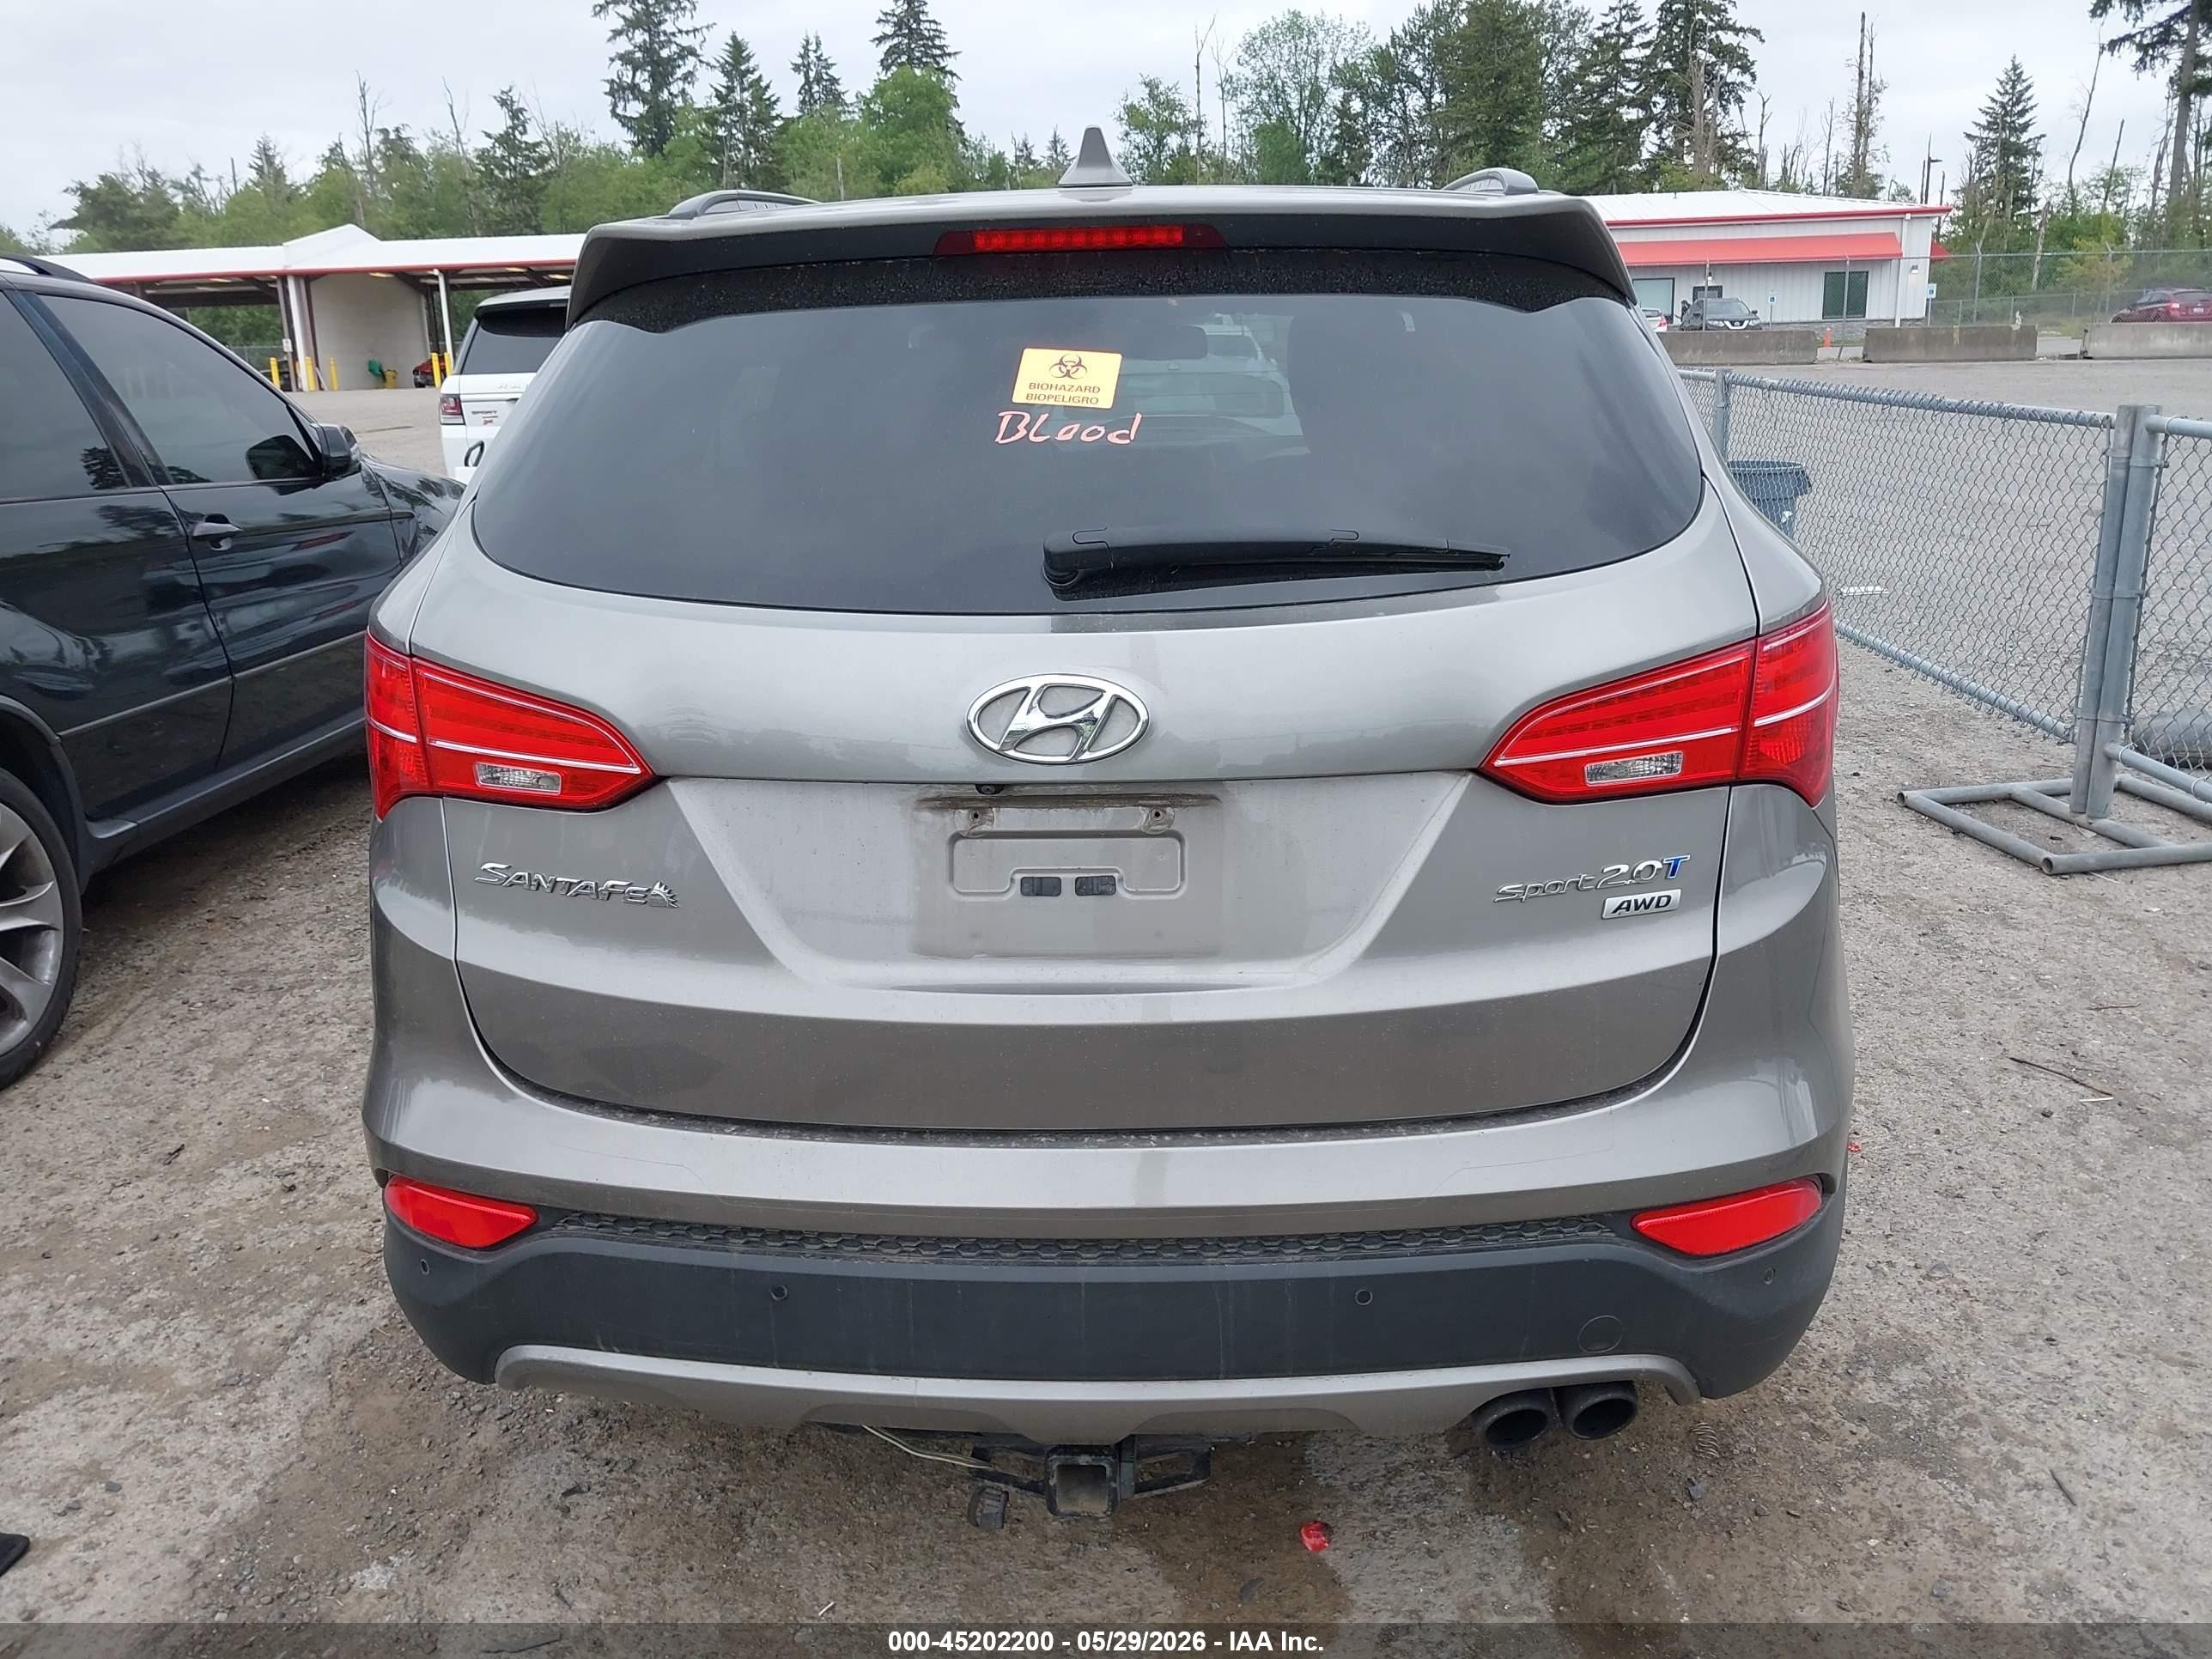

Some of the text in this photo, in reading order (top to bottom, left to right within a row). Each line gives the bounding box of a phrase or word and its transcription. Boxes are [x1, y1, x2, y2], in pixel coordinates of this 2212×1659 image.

[1028, 382, 1101, 394] BIOHAZARD
[1025, 393, 1099, 405] BIOPELIGRO
[1610, 895, 1673, 915] AWD
